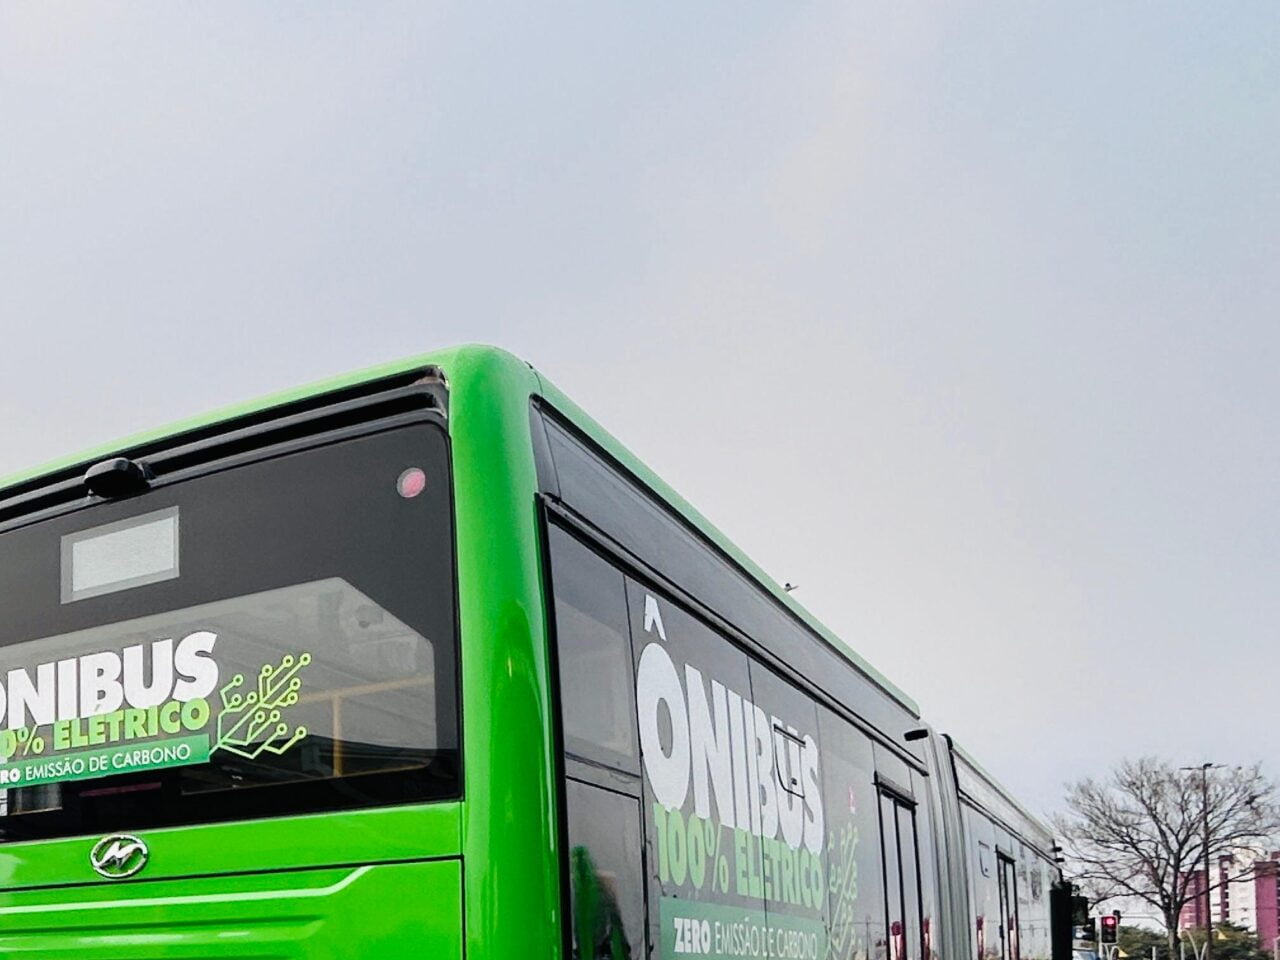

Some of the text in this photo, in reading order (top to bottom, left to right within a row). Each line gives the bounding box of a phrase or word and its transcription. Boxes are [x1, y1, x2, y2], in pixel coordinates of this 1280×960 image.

[637, 594, 825, 856] ÔNIBUS
[25, 757, 83, 781] EMISSÃO
[90, 756, 108, 772] DE
[112, 744, 191, 768] CARBONO
[653, 802, 729, 894] 100%
[674, 916, 818, 960] ZERO EMISSÃO DE CARBONO
